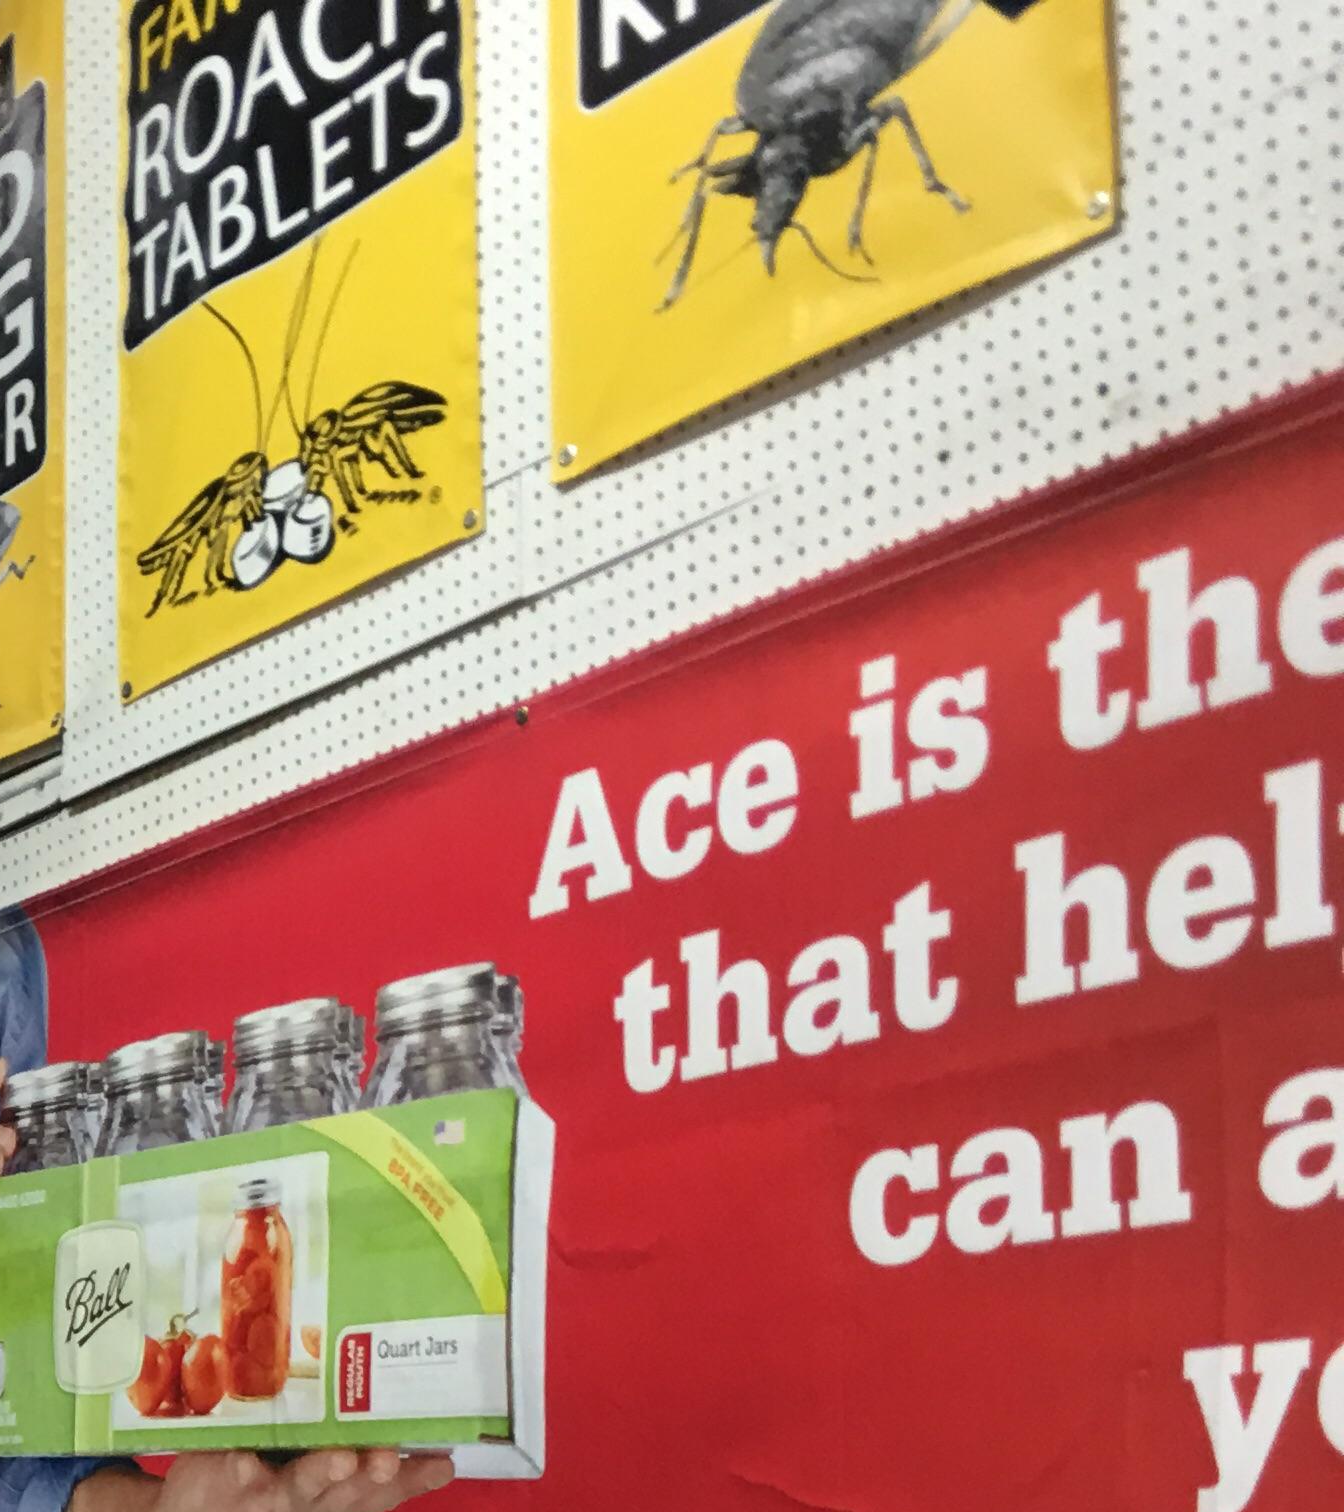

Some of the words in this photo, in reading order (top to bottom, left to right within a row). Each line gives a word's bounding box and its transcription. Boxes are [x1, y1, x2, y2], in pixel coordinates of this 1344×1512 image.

[139, 0, 240, 92] FA
[133, 31, 451, 321] TABLETS
[528, 736, 801, 919] Ace
[849, 653, 990, 819] is
[1048, 533, 1344, 751] the
[614, 879, 960, 1095] that
[1012, 759, 1344, 1006] hel
[849, 1097, 1192, 1267] can
[65, 1262, 133, 1346] Ball
[377, 1338, 421, 1359] Quart
[425, 1336, 458, 1356] Jars
